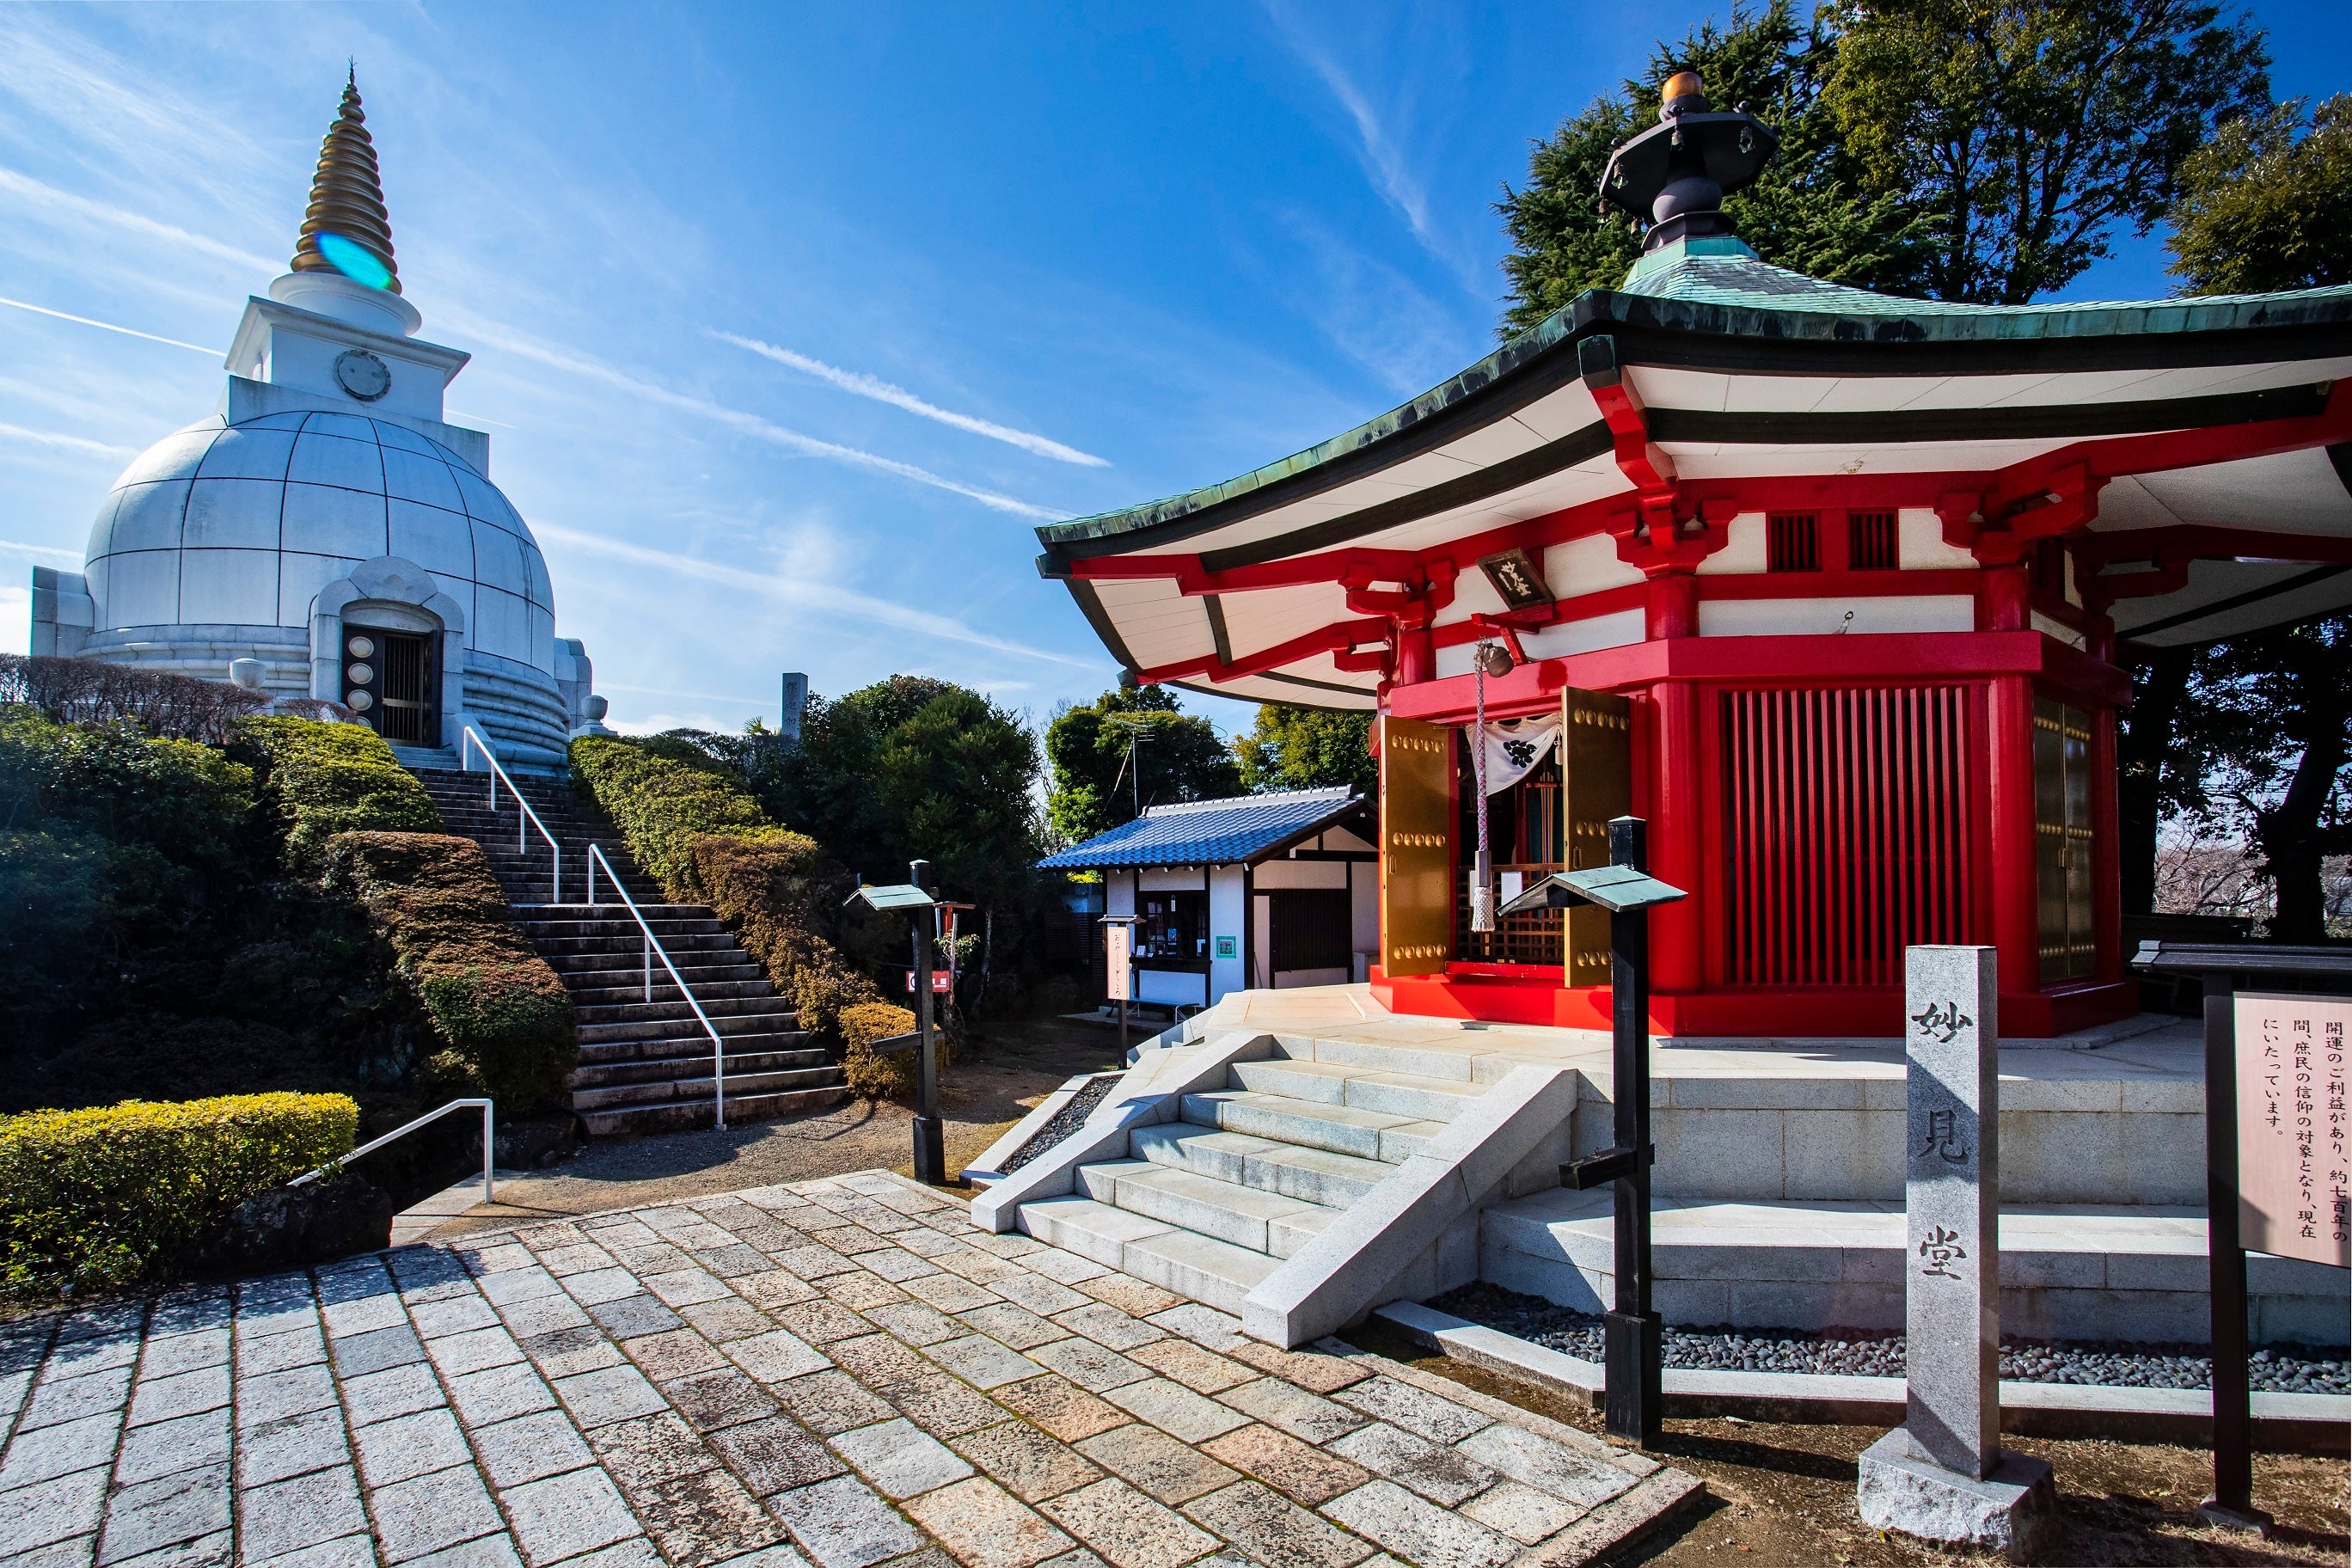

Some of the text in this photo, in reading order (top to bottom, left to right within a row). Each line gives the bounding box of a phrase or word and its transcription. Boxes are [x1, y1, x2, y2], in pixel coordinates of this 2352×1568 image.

[1911, 1001, 1973, 1280] 妙見堂
[2263, 1019, 2283, 1136] にいたっています。
[2294, 1020, 2317, 1239] 間、庶民の信仰の対象となり、現在
[2324, 1021, 2349, 1242] 開運のご利益があり、約七百年の
